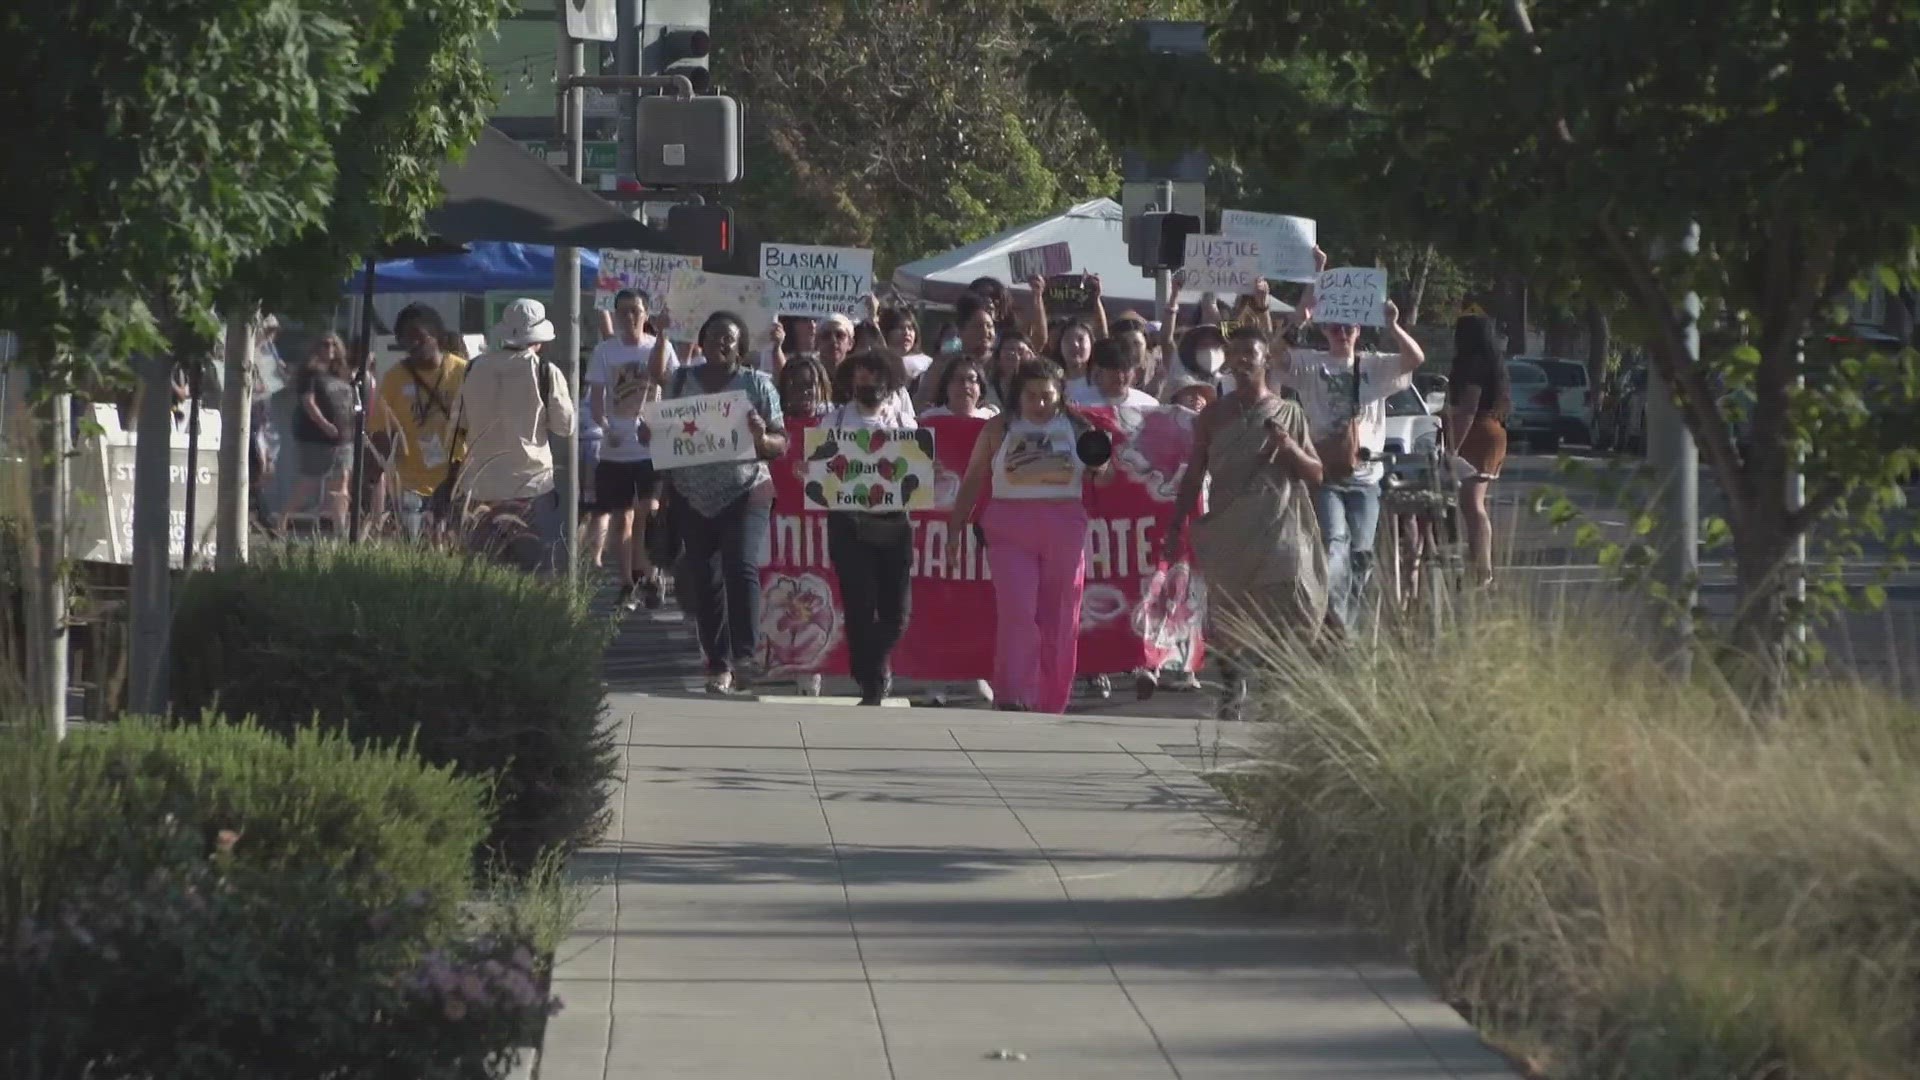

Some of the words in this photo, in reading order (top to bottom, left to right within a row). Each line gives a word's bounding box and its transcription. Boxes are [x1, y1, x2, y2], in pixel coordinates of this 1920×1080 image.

[765, 247, 839, 269] BLASIAN
[1187, 240, 1260, 257] JUSTICE
[765, 269, 864, 295] SOLIDARITY
[1320, 273, 1378, 290] BLACK
[1085, 514, 1157, 580] ATE
